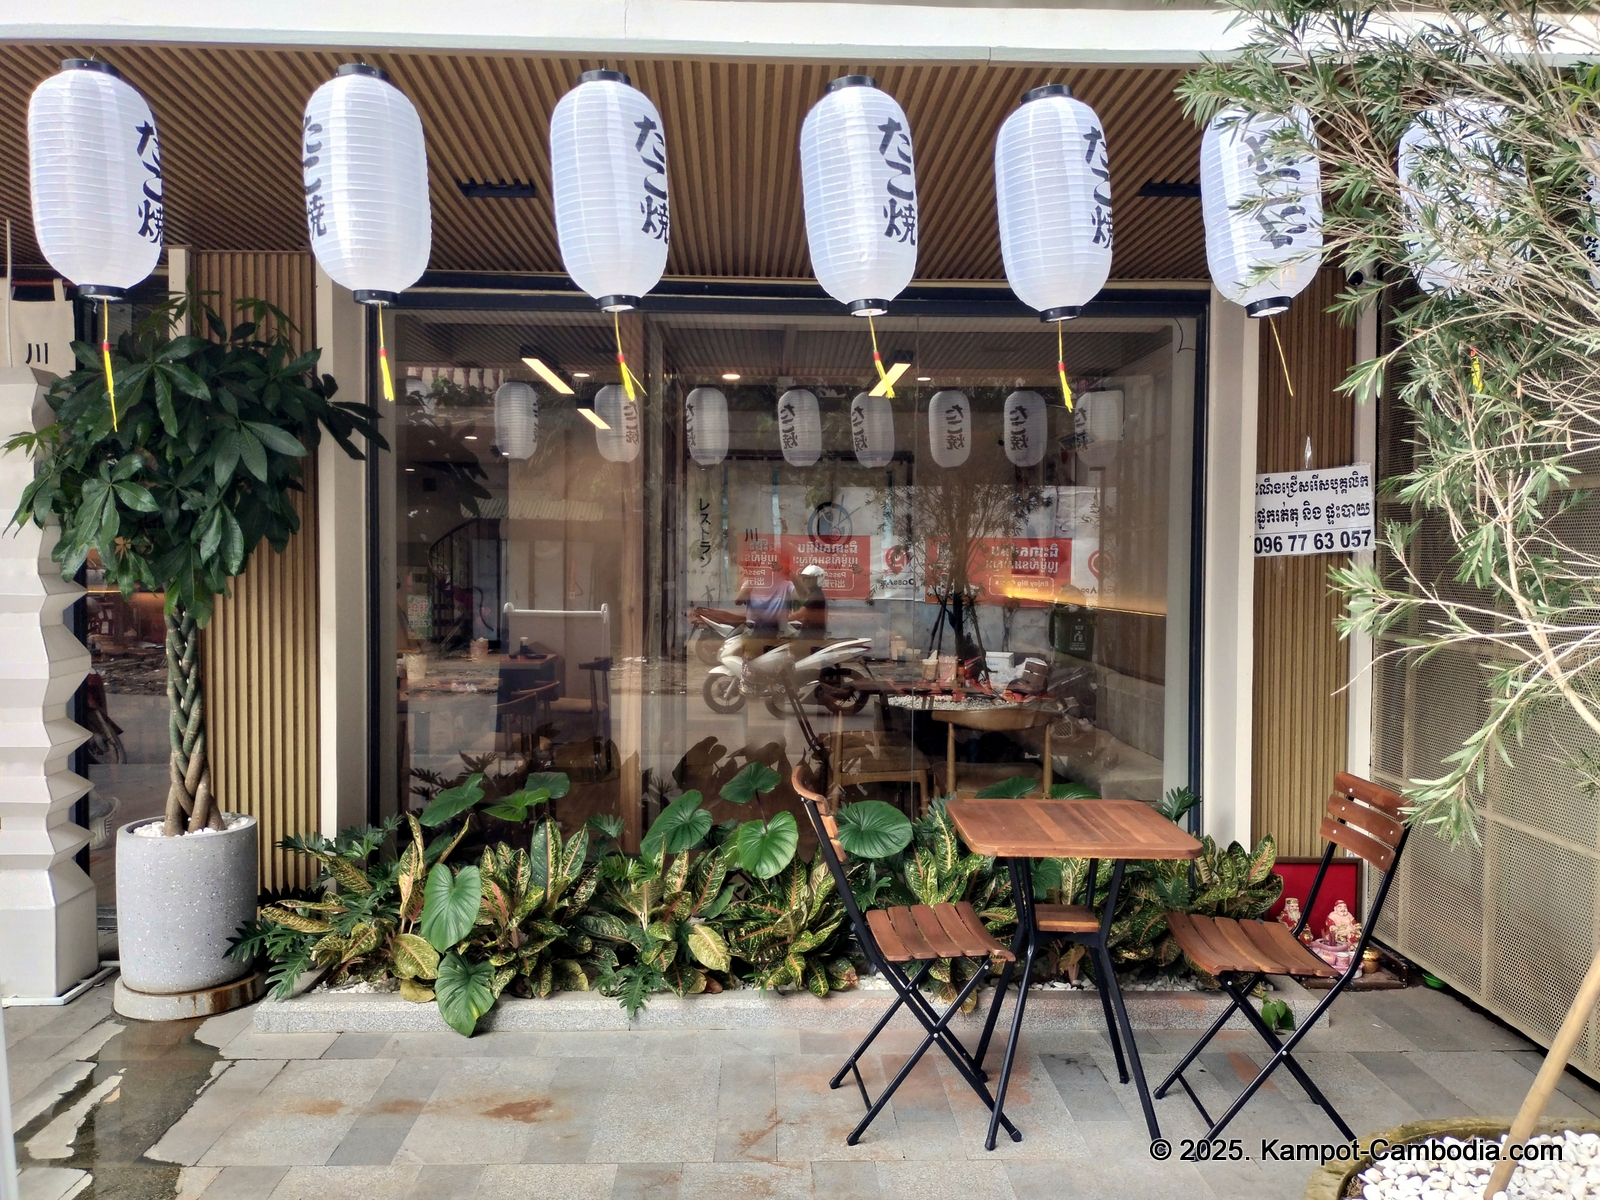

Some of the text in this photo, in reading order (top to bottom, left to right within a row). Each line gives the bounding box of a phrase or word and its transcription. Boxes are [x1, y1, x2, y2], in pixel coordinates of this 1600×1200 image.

[634, 114, 669, 246] たこ焼
[878, 117, 916, 247] たこ焼
[25, 342, 49, 365] 川
[699, 498, 711, 568] レストラン
[1302, 500, 1321, 520] និង
[1254, 529, 1372, 554] 096 77 63 057
